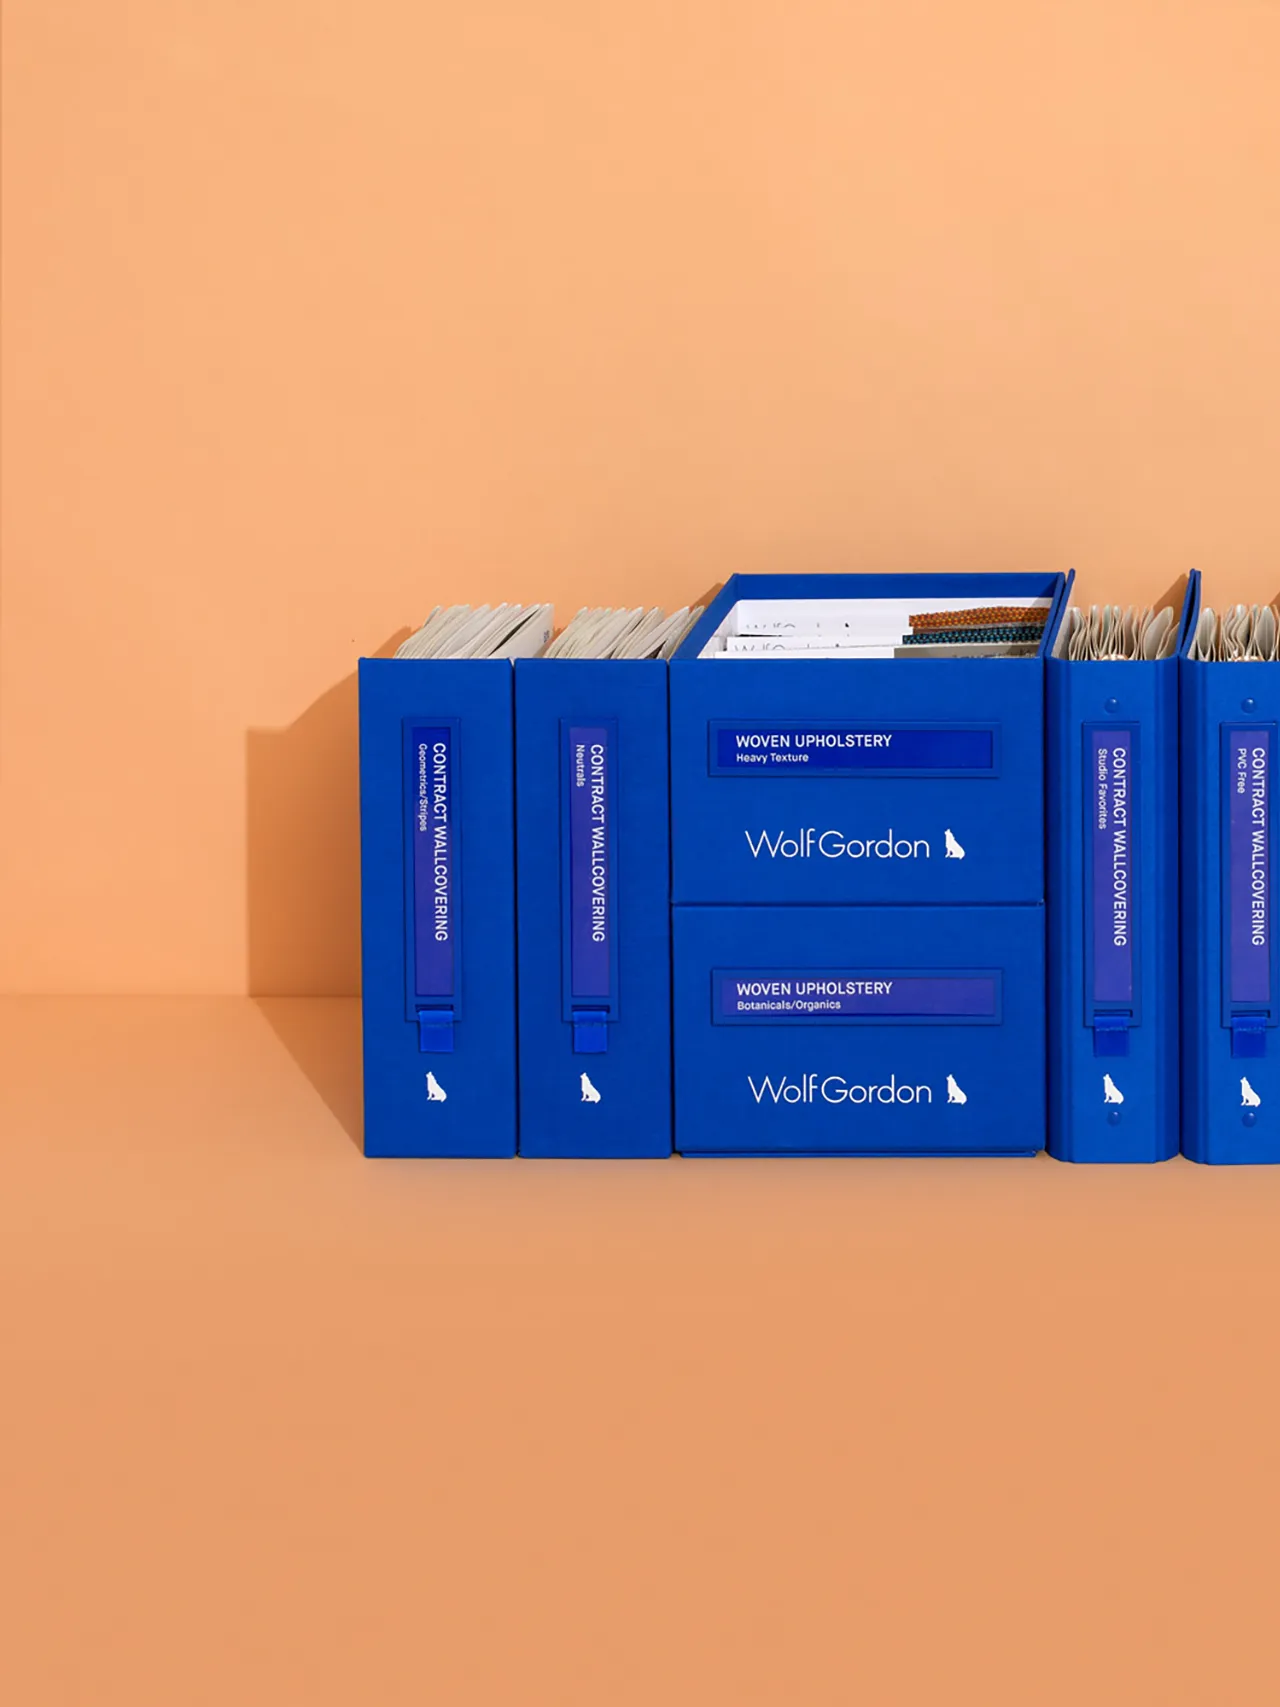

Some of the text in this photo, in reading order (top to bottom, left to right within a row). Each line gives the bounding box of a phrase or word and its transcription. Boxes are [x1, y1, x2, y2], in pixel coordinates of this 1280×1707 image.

[575, 744, 587, 788] Neutrals
[735, 734, 893, 749] WOVEN UPHOLSTERY
[736, 752, 810, 765] Heavy Texture
[1237, 747, 1248, 794] PVC Free
[417, 743, 429, 832] Geometrics/Stripes
[1097, 748, 1108, 830] Studio Favorites
[432, 742, 449, 942] CONTRACT WALLCOVERING
[590, 744, 606, 942] CONTRACT WALLCOVERING
[1112, 747, 1127, 947] CONTRACT WALLCOVERING
[1251, 747, 1266, 946] CONTRACT WALLCOVERING
[736, 981, 893, 996] WOVEN UPHOLSTERY
[737, 999, 842, 1013] Botanicals/Organics
